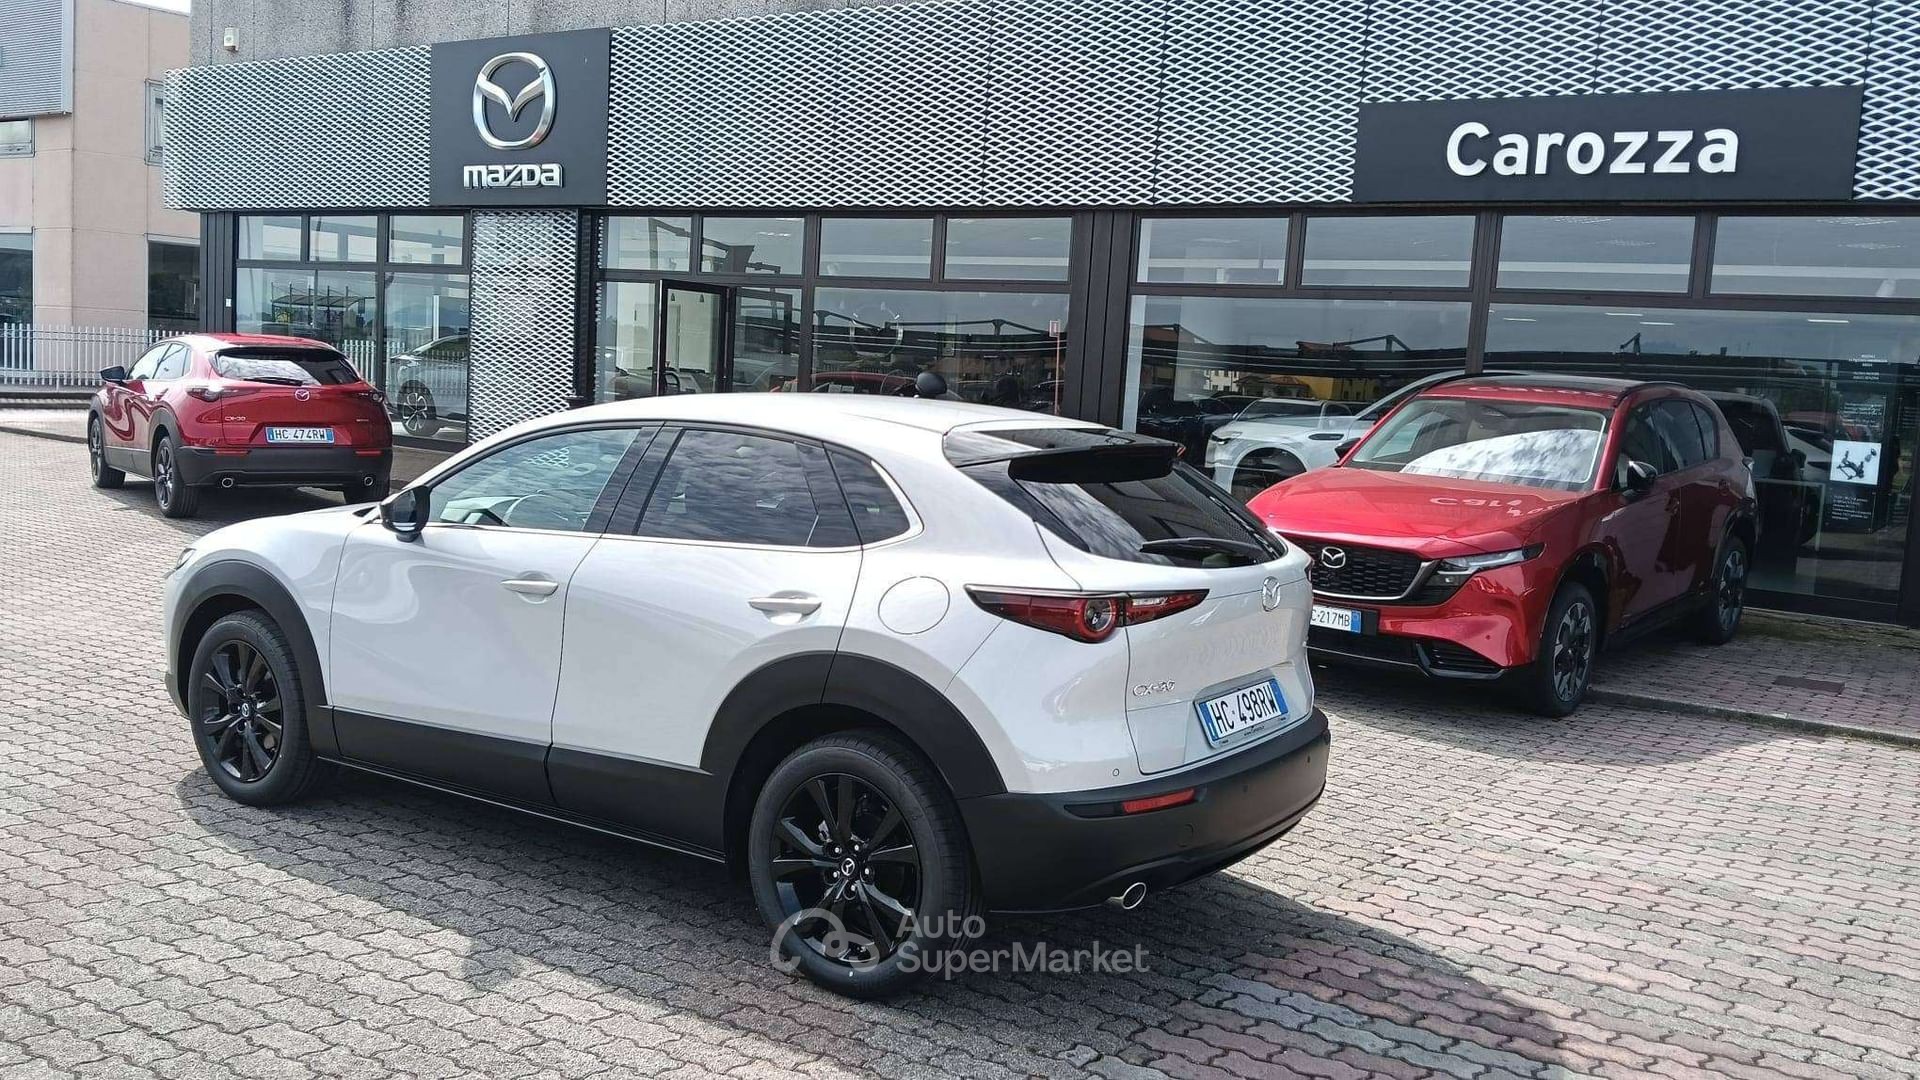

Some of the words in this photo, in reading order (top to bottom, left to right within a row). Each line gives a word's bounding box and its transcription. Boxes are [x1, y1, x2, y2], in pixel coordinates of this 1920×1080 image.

[1445, 121, 1739, 177] Carozza
[463, 163, 563, 188] mazda
[274, 429, 289, 440] HC
[293, 429, 326, 440] 474RW
[1319, 610, 1351, 627] 217MB
[1210, 700, 1235, 733] HC
[1236, 684, 1279, 725] 498RW
